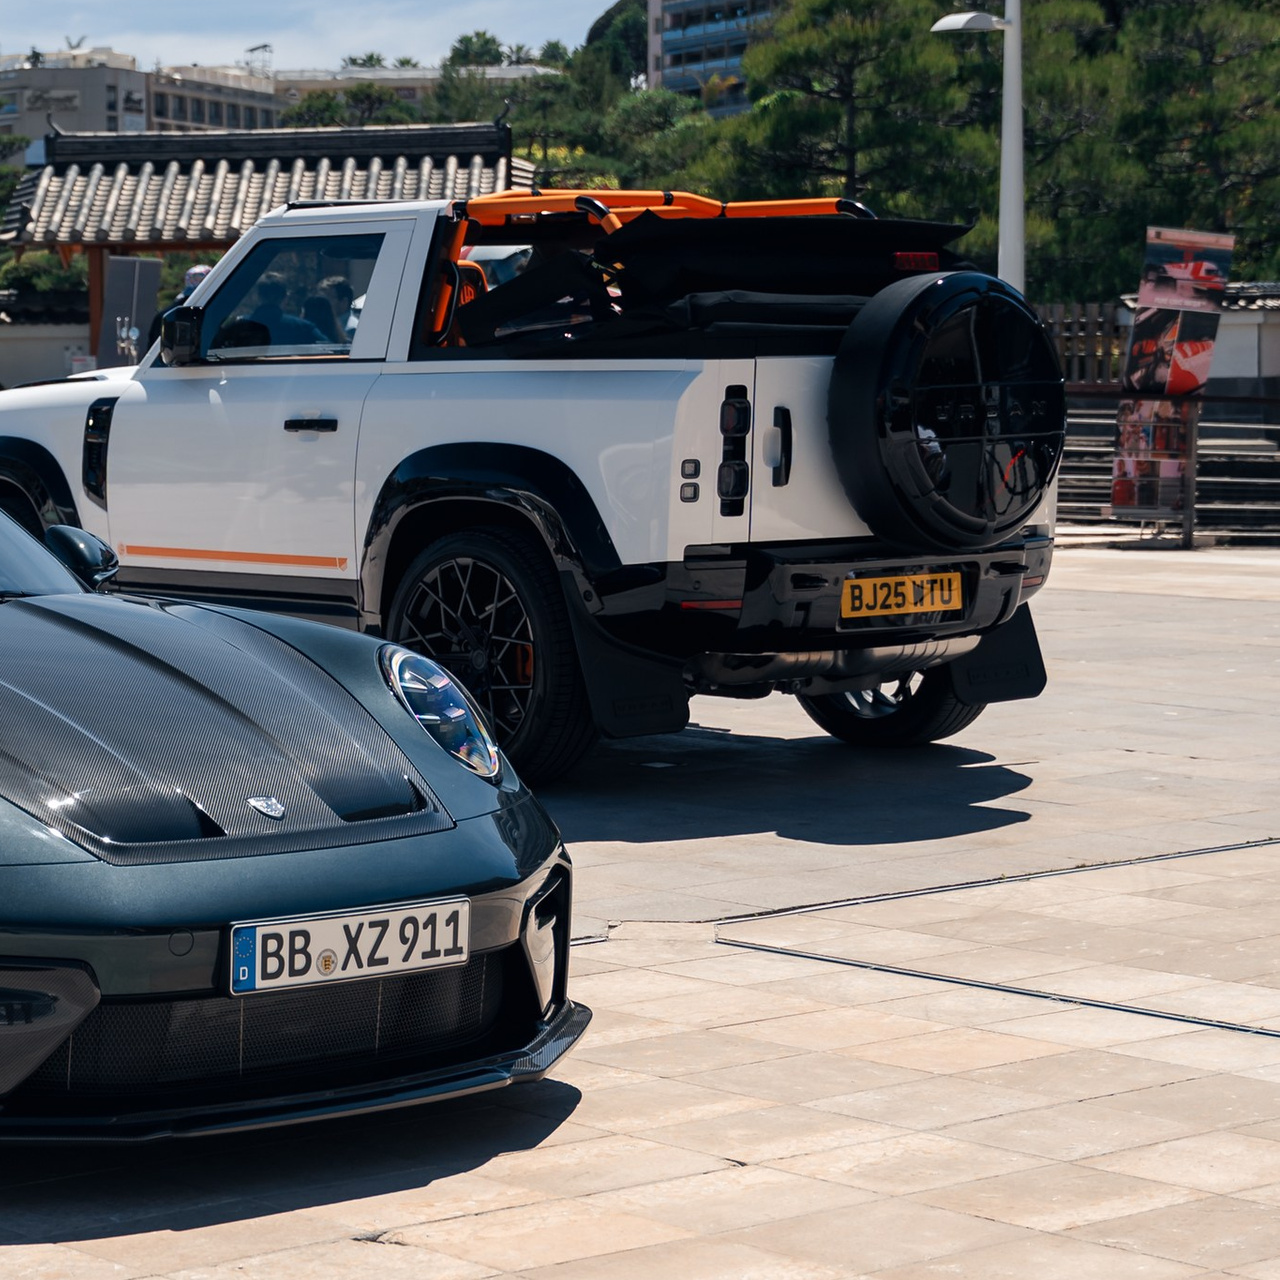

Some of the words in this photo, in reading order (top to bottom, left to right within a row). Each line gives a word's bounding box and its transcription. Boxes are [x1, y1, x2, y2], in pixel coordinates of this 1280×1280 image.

[935, 400, 1047, 421] URBAN
[849, 581, 906, 612] BJ25
[261, 928, 312, 981] BB
[341, 919, 390, 971] XZ
[398, 910, 464, 963] 911
[239, 966, 249, 981] D
